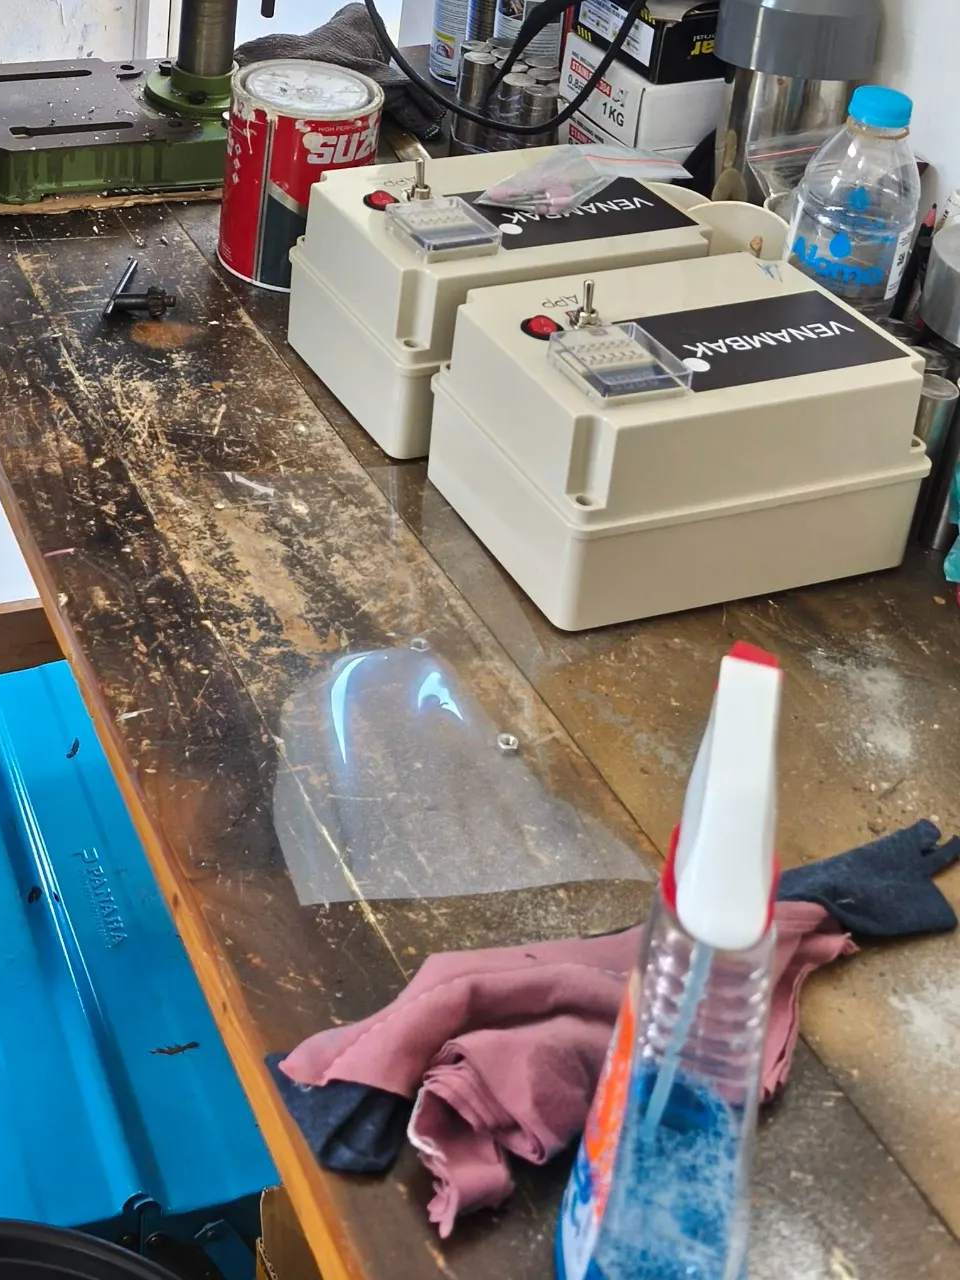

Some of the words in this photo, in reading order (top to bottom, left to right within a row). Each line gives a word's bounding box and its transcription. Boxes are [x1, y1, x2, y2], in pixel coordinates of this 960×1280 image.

[690, 40, 715, 55] ar
[541, 293, 580, 309] APP
[682, 320, 855, 358] VENAMBAK
